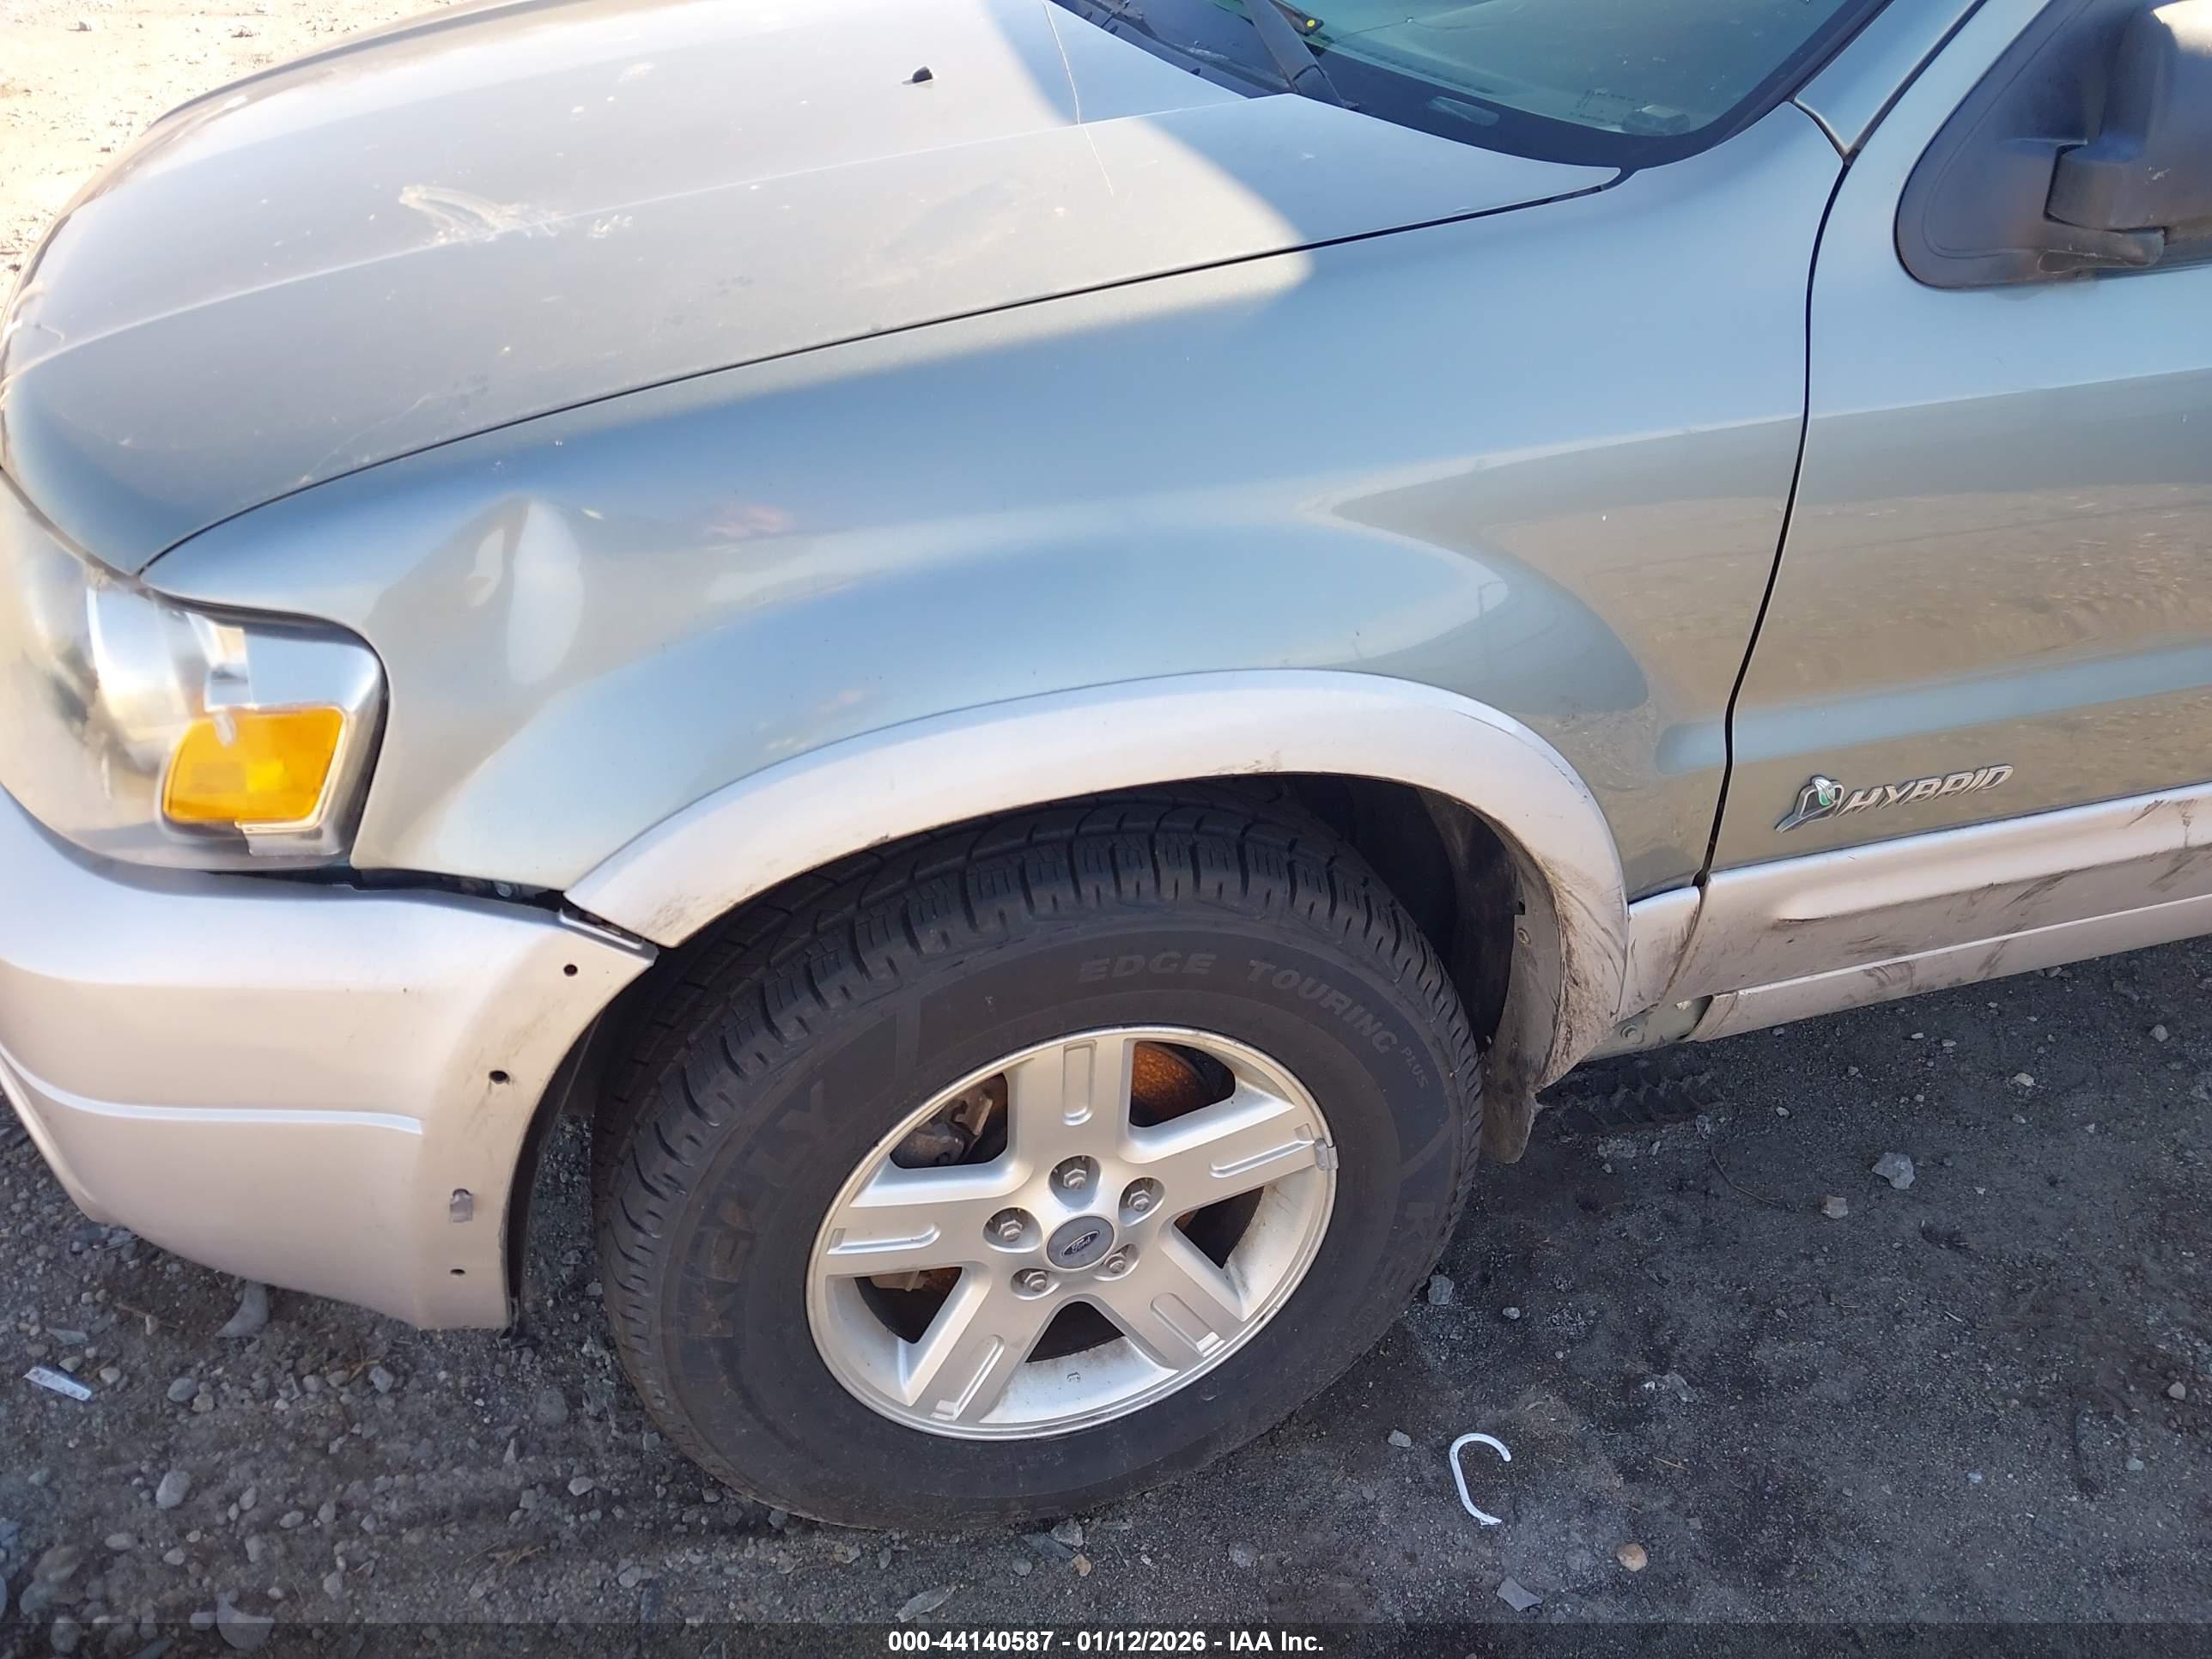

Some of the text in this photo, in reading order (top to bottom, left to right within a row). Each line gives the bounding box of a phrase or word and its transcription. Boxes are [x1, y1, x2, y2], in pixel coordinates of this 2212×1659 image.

[1837, 763, 2014, 817] HYBRID
[1079, 952, 1430, 1089] EDGE TOURING PLUS
